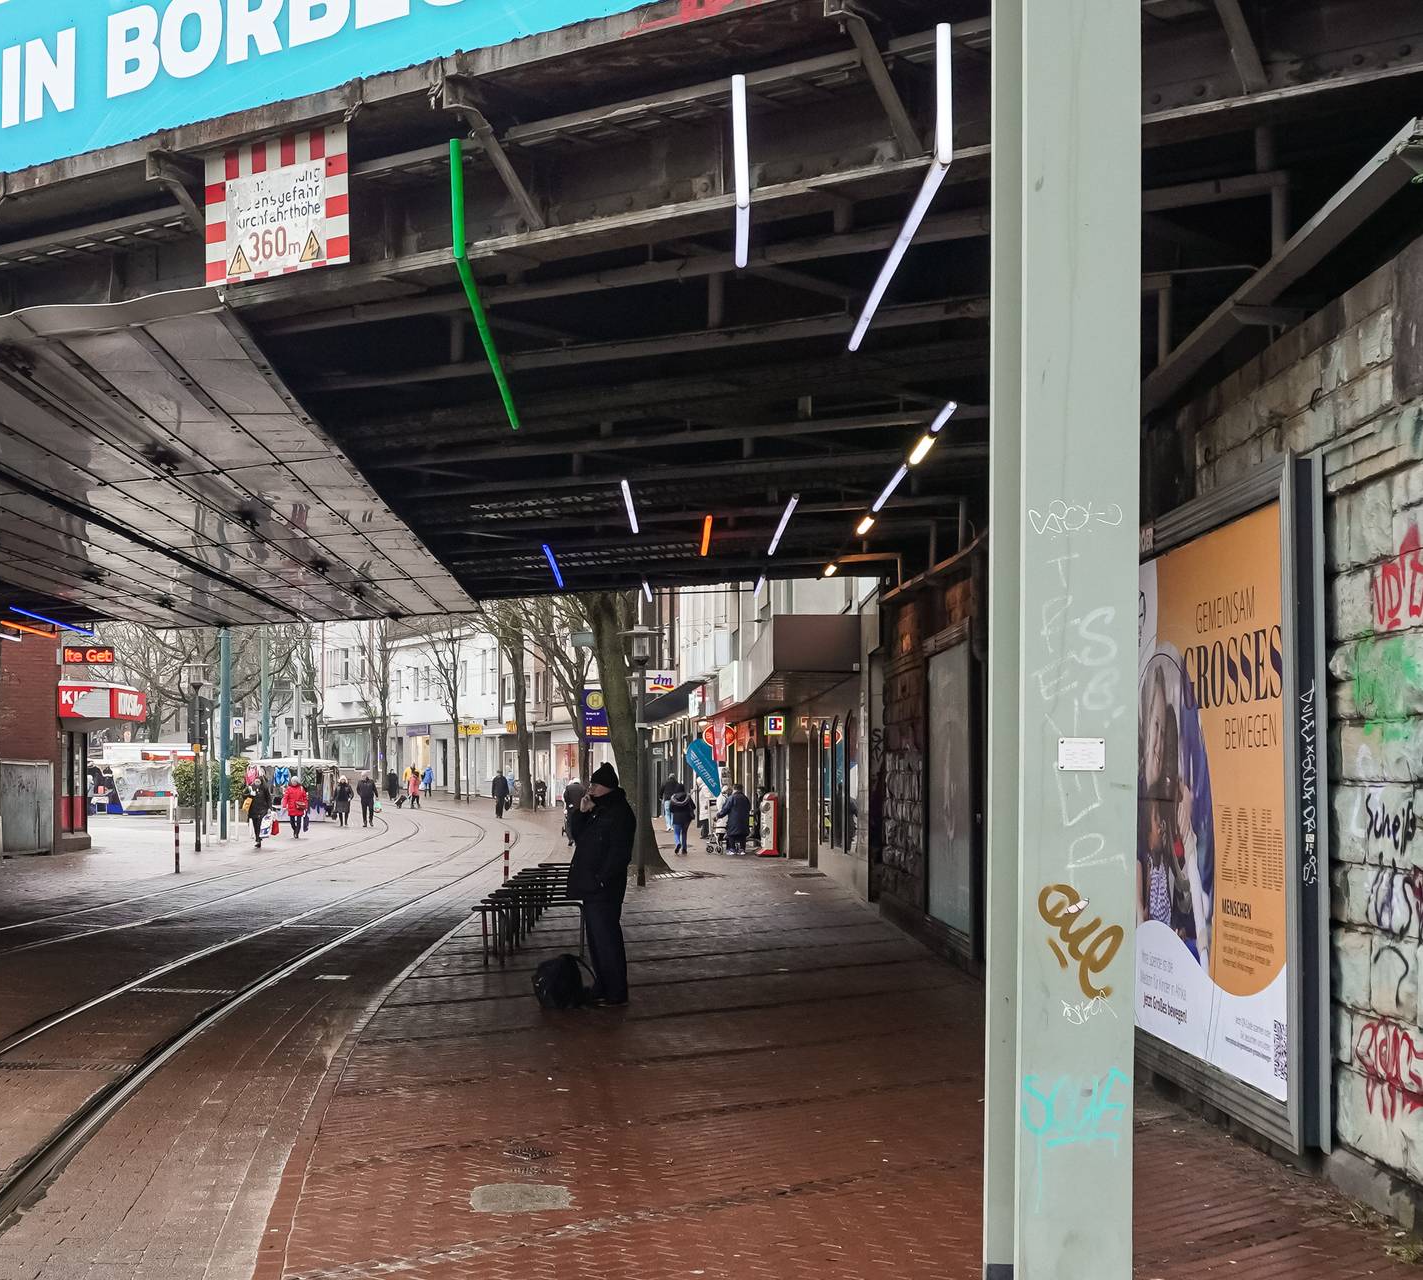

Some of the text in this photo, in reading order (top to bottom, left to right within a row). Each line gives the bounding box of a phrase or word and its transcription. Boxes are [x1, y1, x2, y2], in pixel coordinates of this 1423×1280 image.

[1, 0, 466, 128] IN BORB
[1195, 585, 1255, 634] GEMEINSAM
[654, 674, 672, 685] dm
[1183, 624, 1283, 711] GROSSES
[1224, 713, 1277, 751] BEWEGEN
[693, 756, 717, 788] Hermes
[1221, 898, 1253, 921] MENSCHEN
